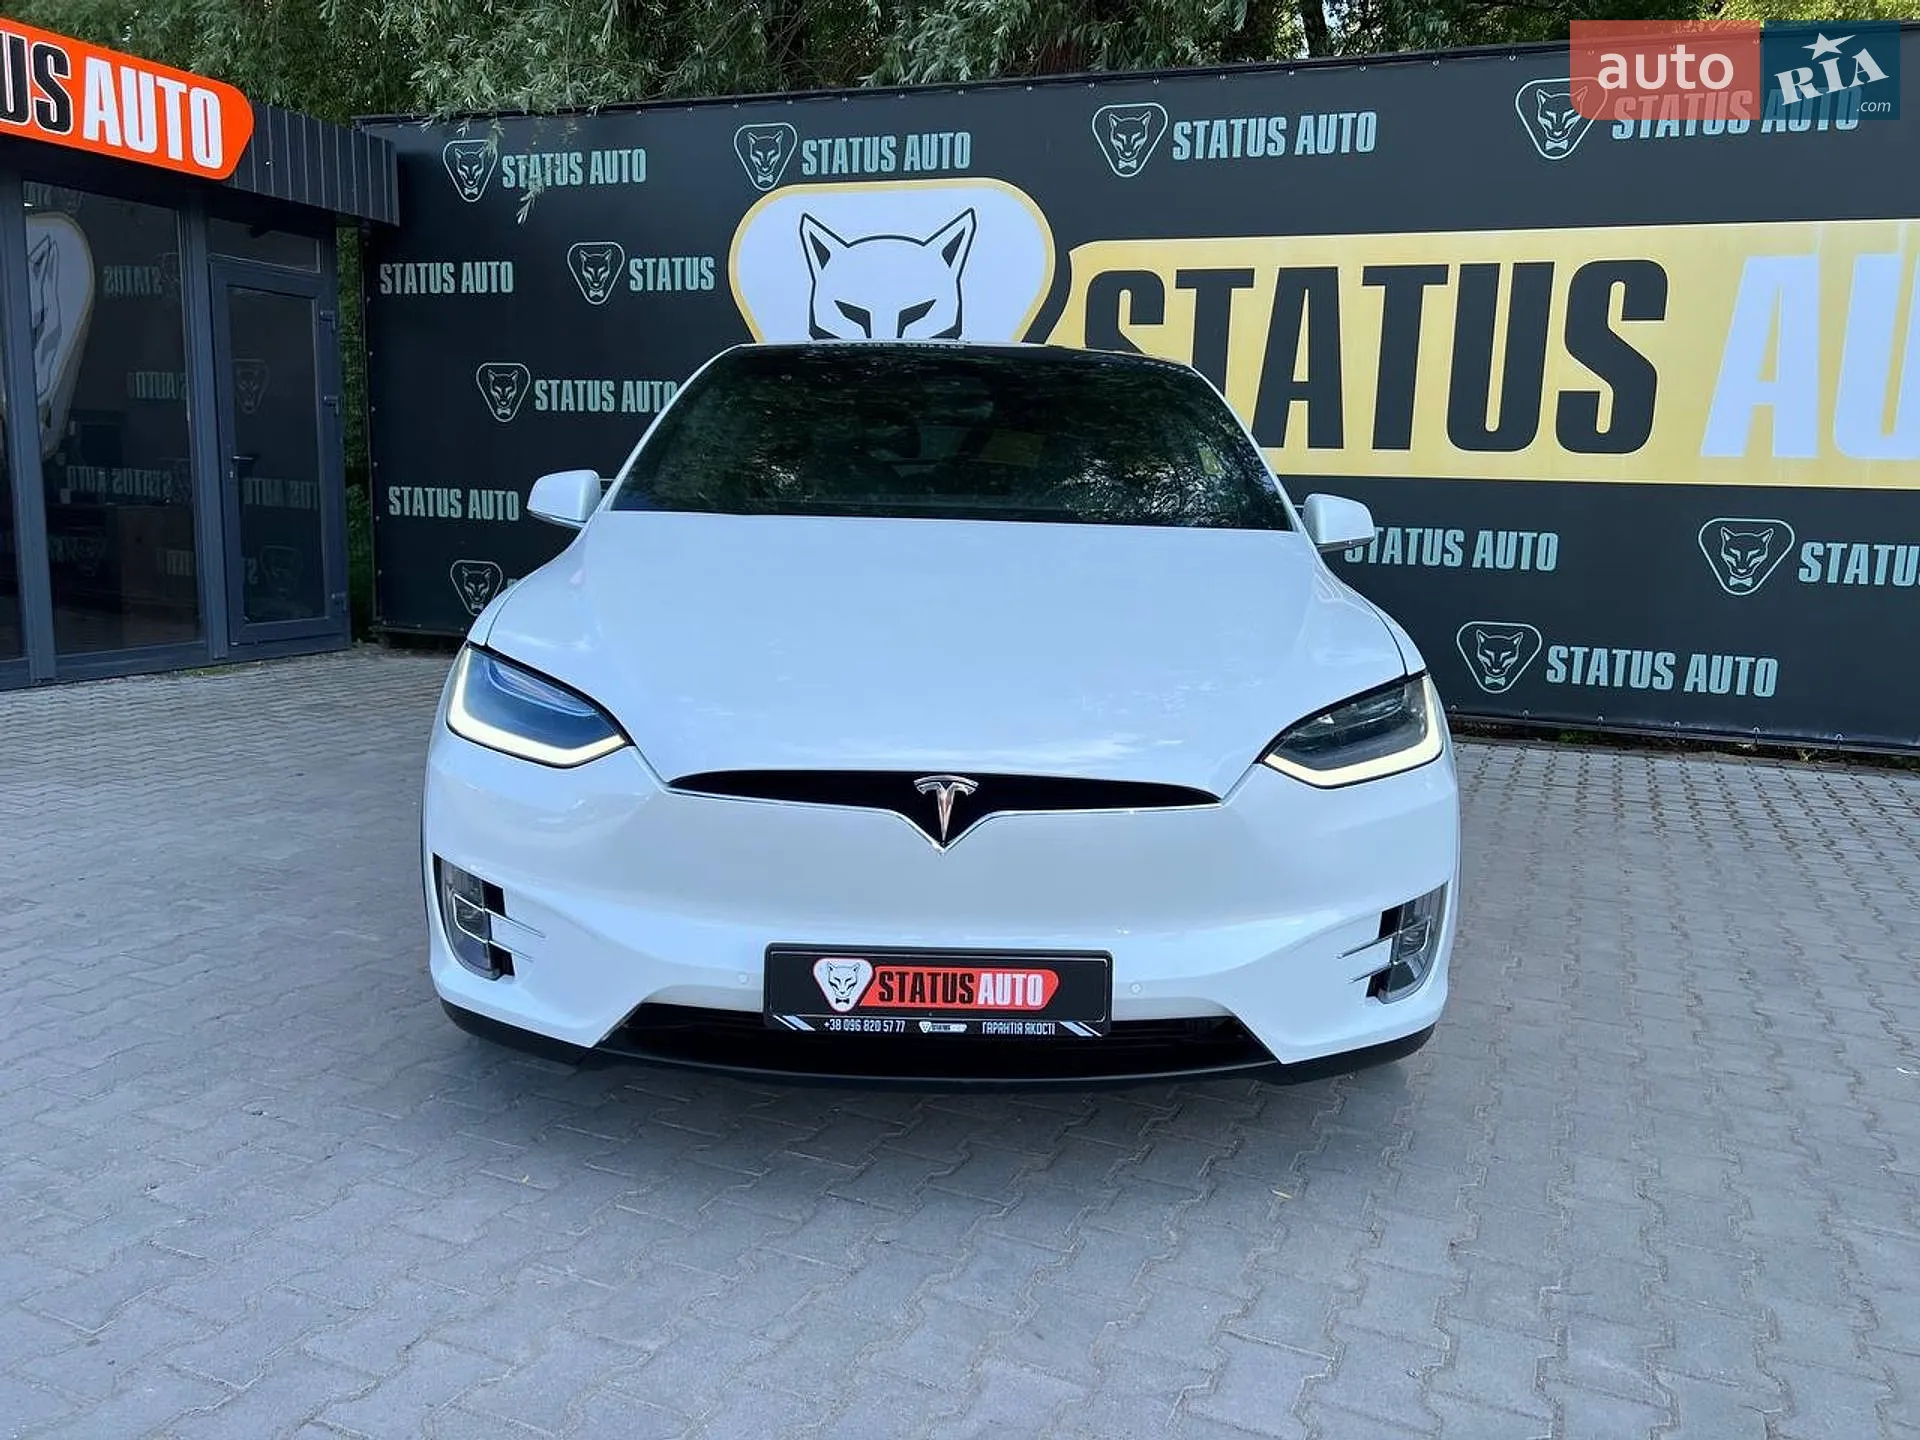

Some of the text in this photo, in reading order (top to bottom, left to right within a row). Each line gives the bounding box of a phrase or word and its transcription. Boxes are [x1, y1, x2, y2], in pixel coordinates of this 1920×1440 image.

[83, 56, 223, 170] AUTO
[1612, 84, 1863, 140] STATUS AUTO
[801, 131, 971, 175] STATUS AUTO
[1172, 111, 1377, 161] STATUS AUTO
[502, 148, 647, 188] STATUS AUTO
[379, 261, 515, 294] STATUS AUTO
[629, 257, 716, 292] STATUS
[1700, 252, 1920, 460] AU
[534, 380, 678, 413] STATUS AUTO
[388, 486, 520, 521] STATUS AUTO
[1472, 530, 1560, 572] AUTO
[1798, 541, 1920, 587] STATU
[1546, 645, 1779, 698] STATUS AUTO
[878, 972, 1044, 1006] STATUS AUTO
[824, 1020, 842, 1031] +38
[844, 1020, 862, 1031] 096
[864, 1020, 881, 1032] 820
